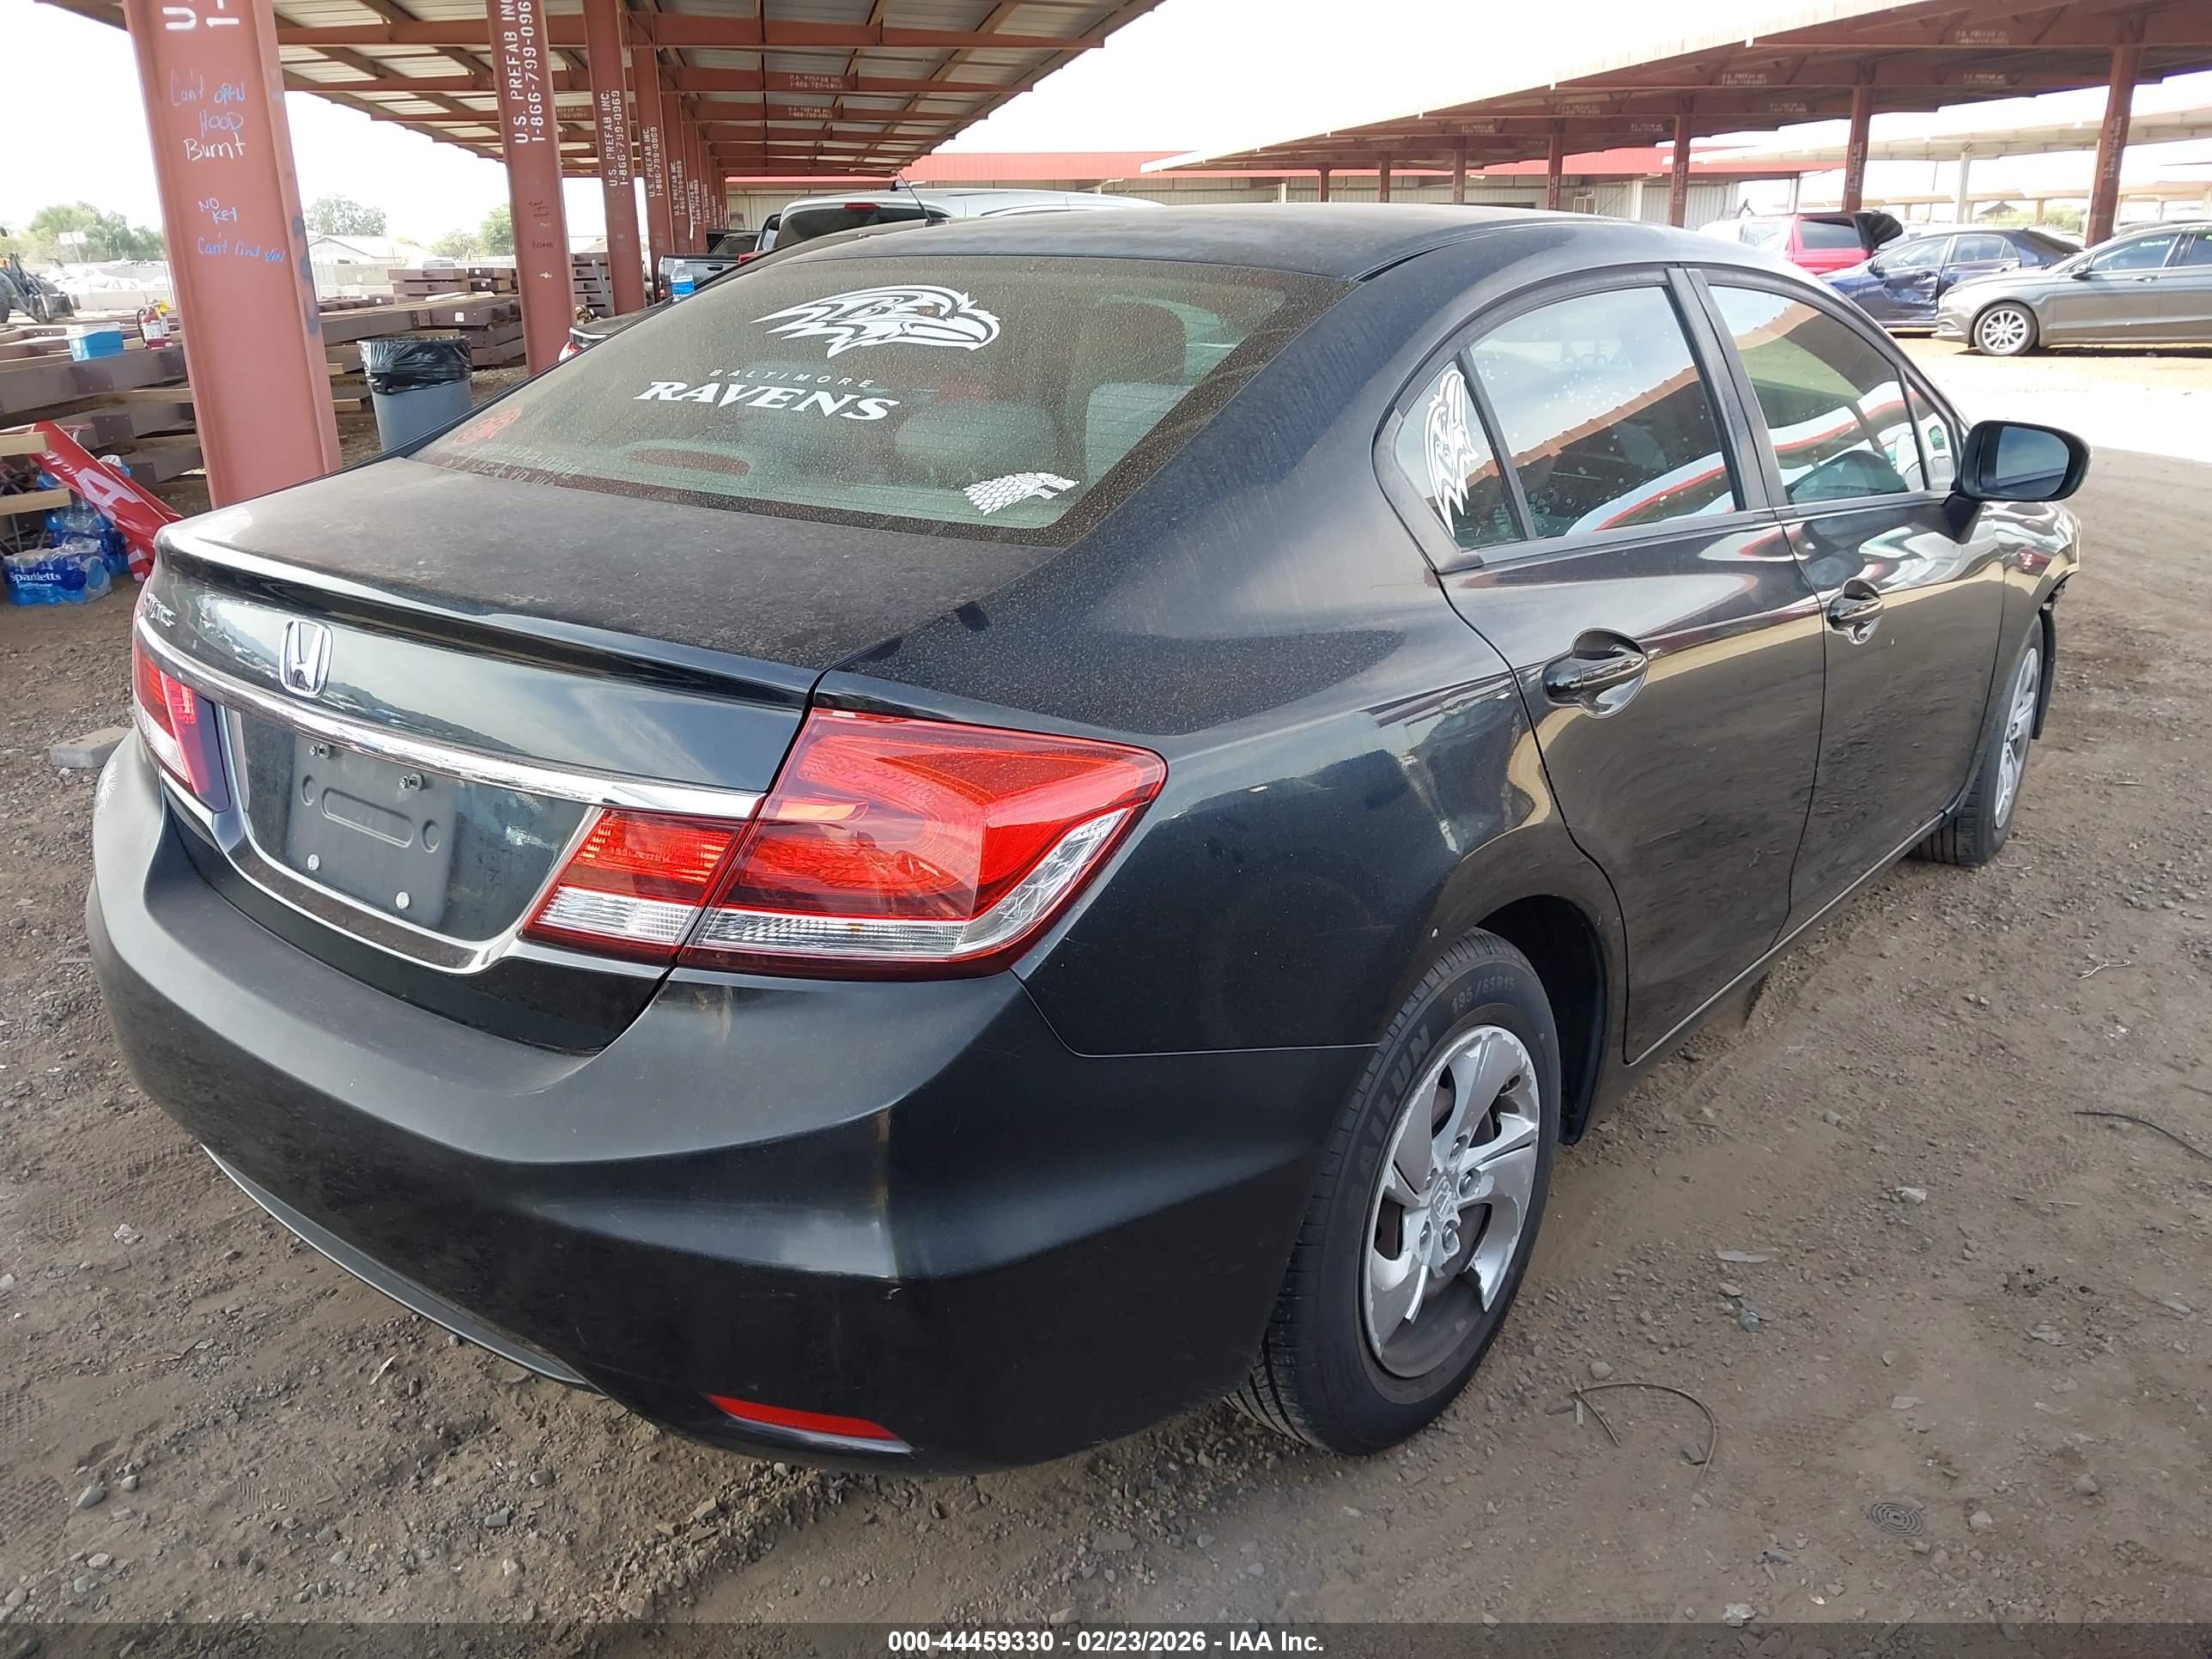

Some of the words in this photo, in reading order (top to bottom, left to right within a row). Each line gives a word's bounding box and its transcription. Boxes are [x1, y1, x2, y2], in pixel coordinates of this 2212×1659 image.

[504, 31, 524, 100] PREFAB
[600, 89, 611, 111] INC.
[514, 110, 529, 143] U.S.
[603, 116, 616, 160] PREFAB
[611, 90, 629, 185] 1-866-799-0969
[183, 131, 246, 161] Burnt
[609, 166, 618, 186] U.S.
[198, 198, 220, 212] NO
[212, 207, 237, 223] KEY
[709, 369, 874, 388] BALTIMORE
[633, 380, 901, 421] RAVENS
[1451, 975, 1516, 1012] 195/65R15
[1349, 1024, 1431, 1204] AILUN
